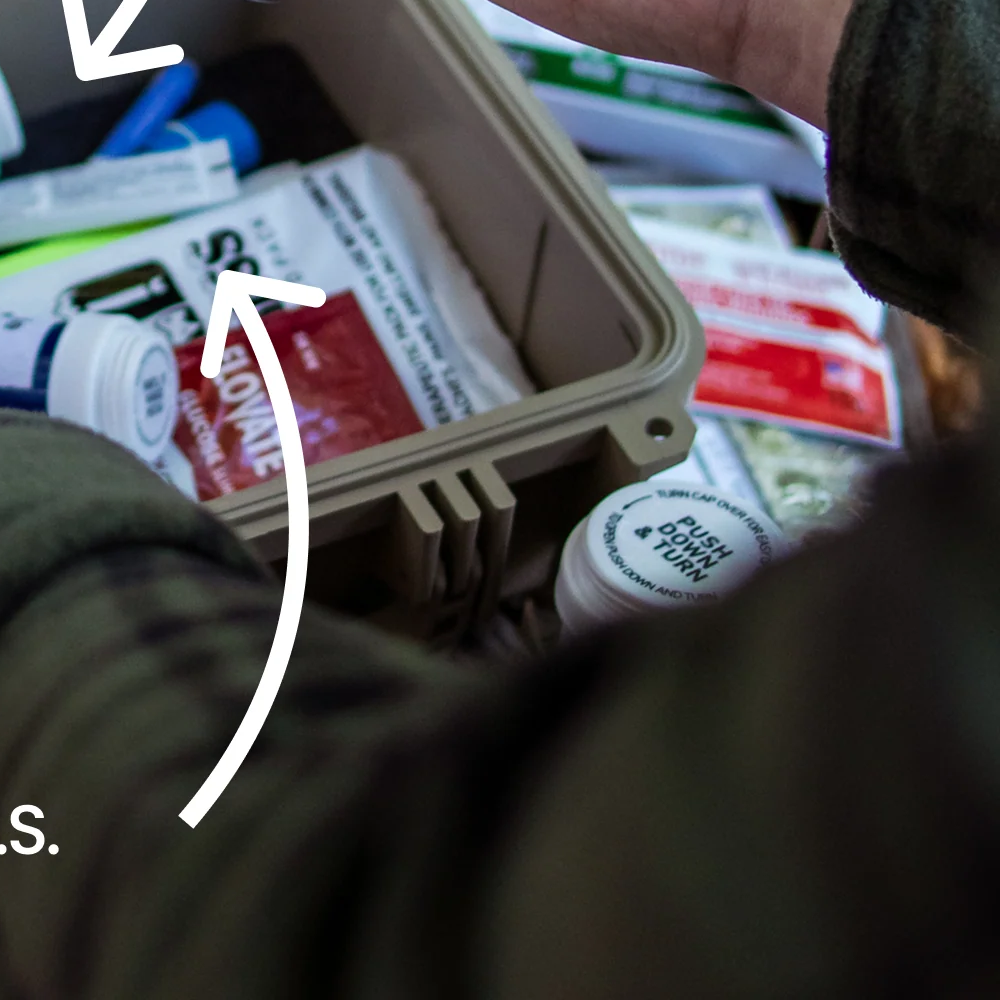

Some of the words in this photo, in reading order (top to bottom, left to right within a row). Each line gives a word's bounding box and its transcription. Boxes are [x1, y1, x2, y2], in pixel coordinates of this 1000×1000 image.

[655, 489, 690, 500] TURN
[691, 491, 716, 504] CAP
[717, 499, 747, 519] OVER
[634, 525, 653, 540] &
[653, 538, 709, 584] TURN
[657, 522, 720, 570] DOWN
[676, 515, 734, 560] PUSH
[622, 565, 656, 591] DOWN
[654, 586, 683, 600] AND
